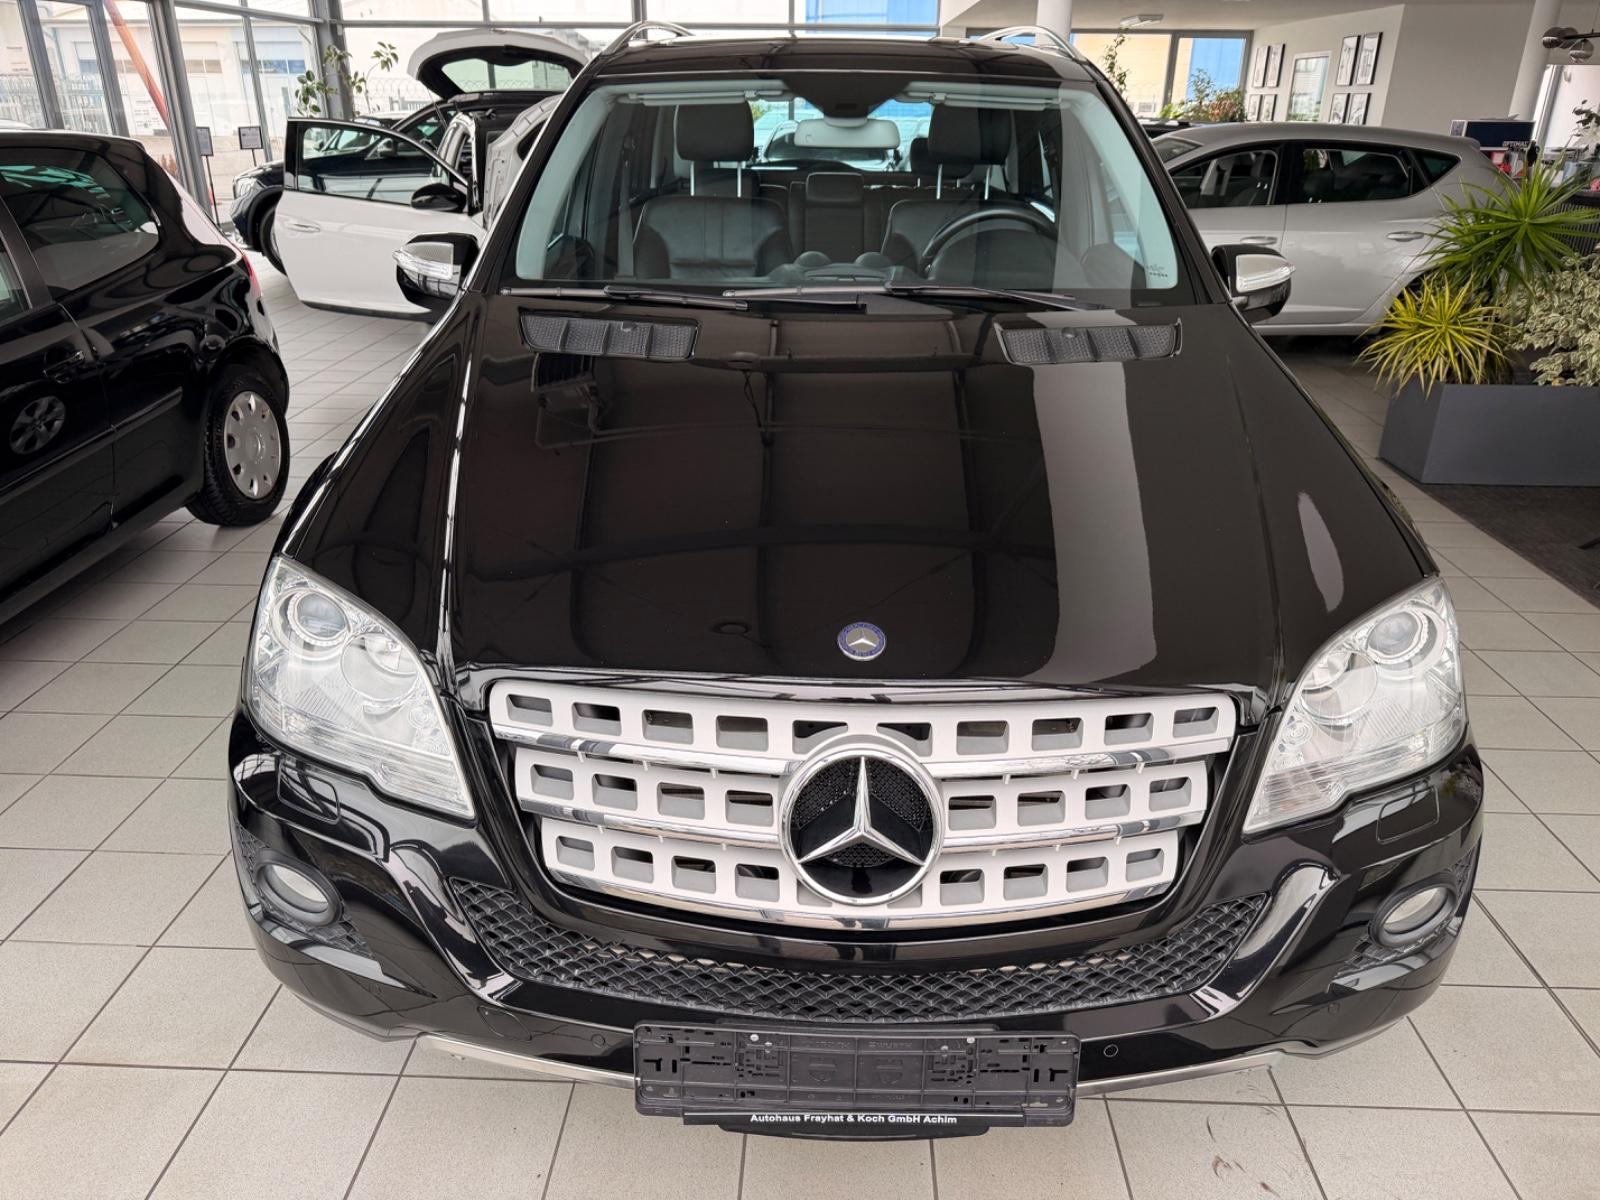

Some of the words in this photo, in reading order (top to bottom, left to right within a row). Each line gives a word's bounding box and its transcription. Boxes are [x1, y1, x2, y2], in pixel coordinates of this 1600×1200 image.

[750, 1114, 801, 1122] Autohaus
[804, 1114, 844, 1124] Frayhat
[847, 1114, 855, 1122] &
[858, 1114, 885, 1122] Koch
[888, 1114, 921, 1123] GmbH
[923, 1115, 957, 1124] Achim
